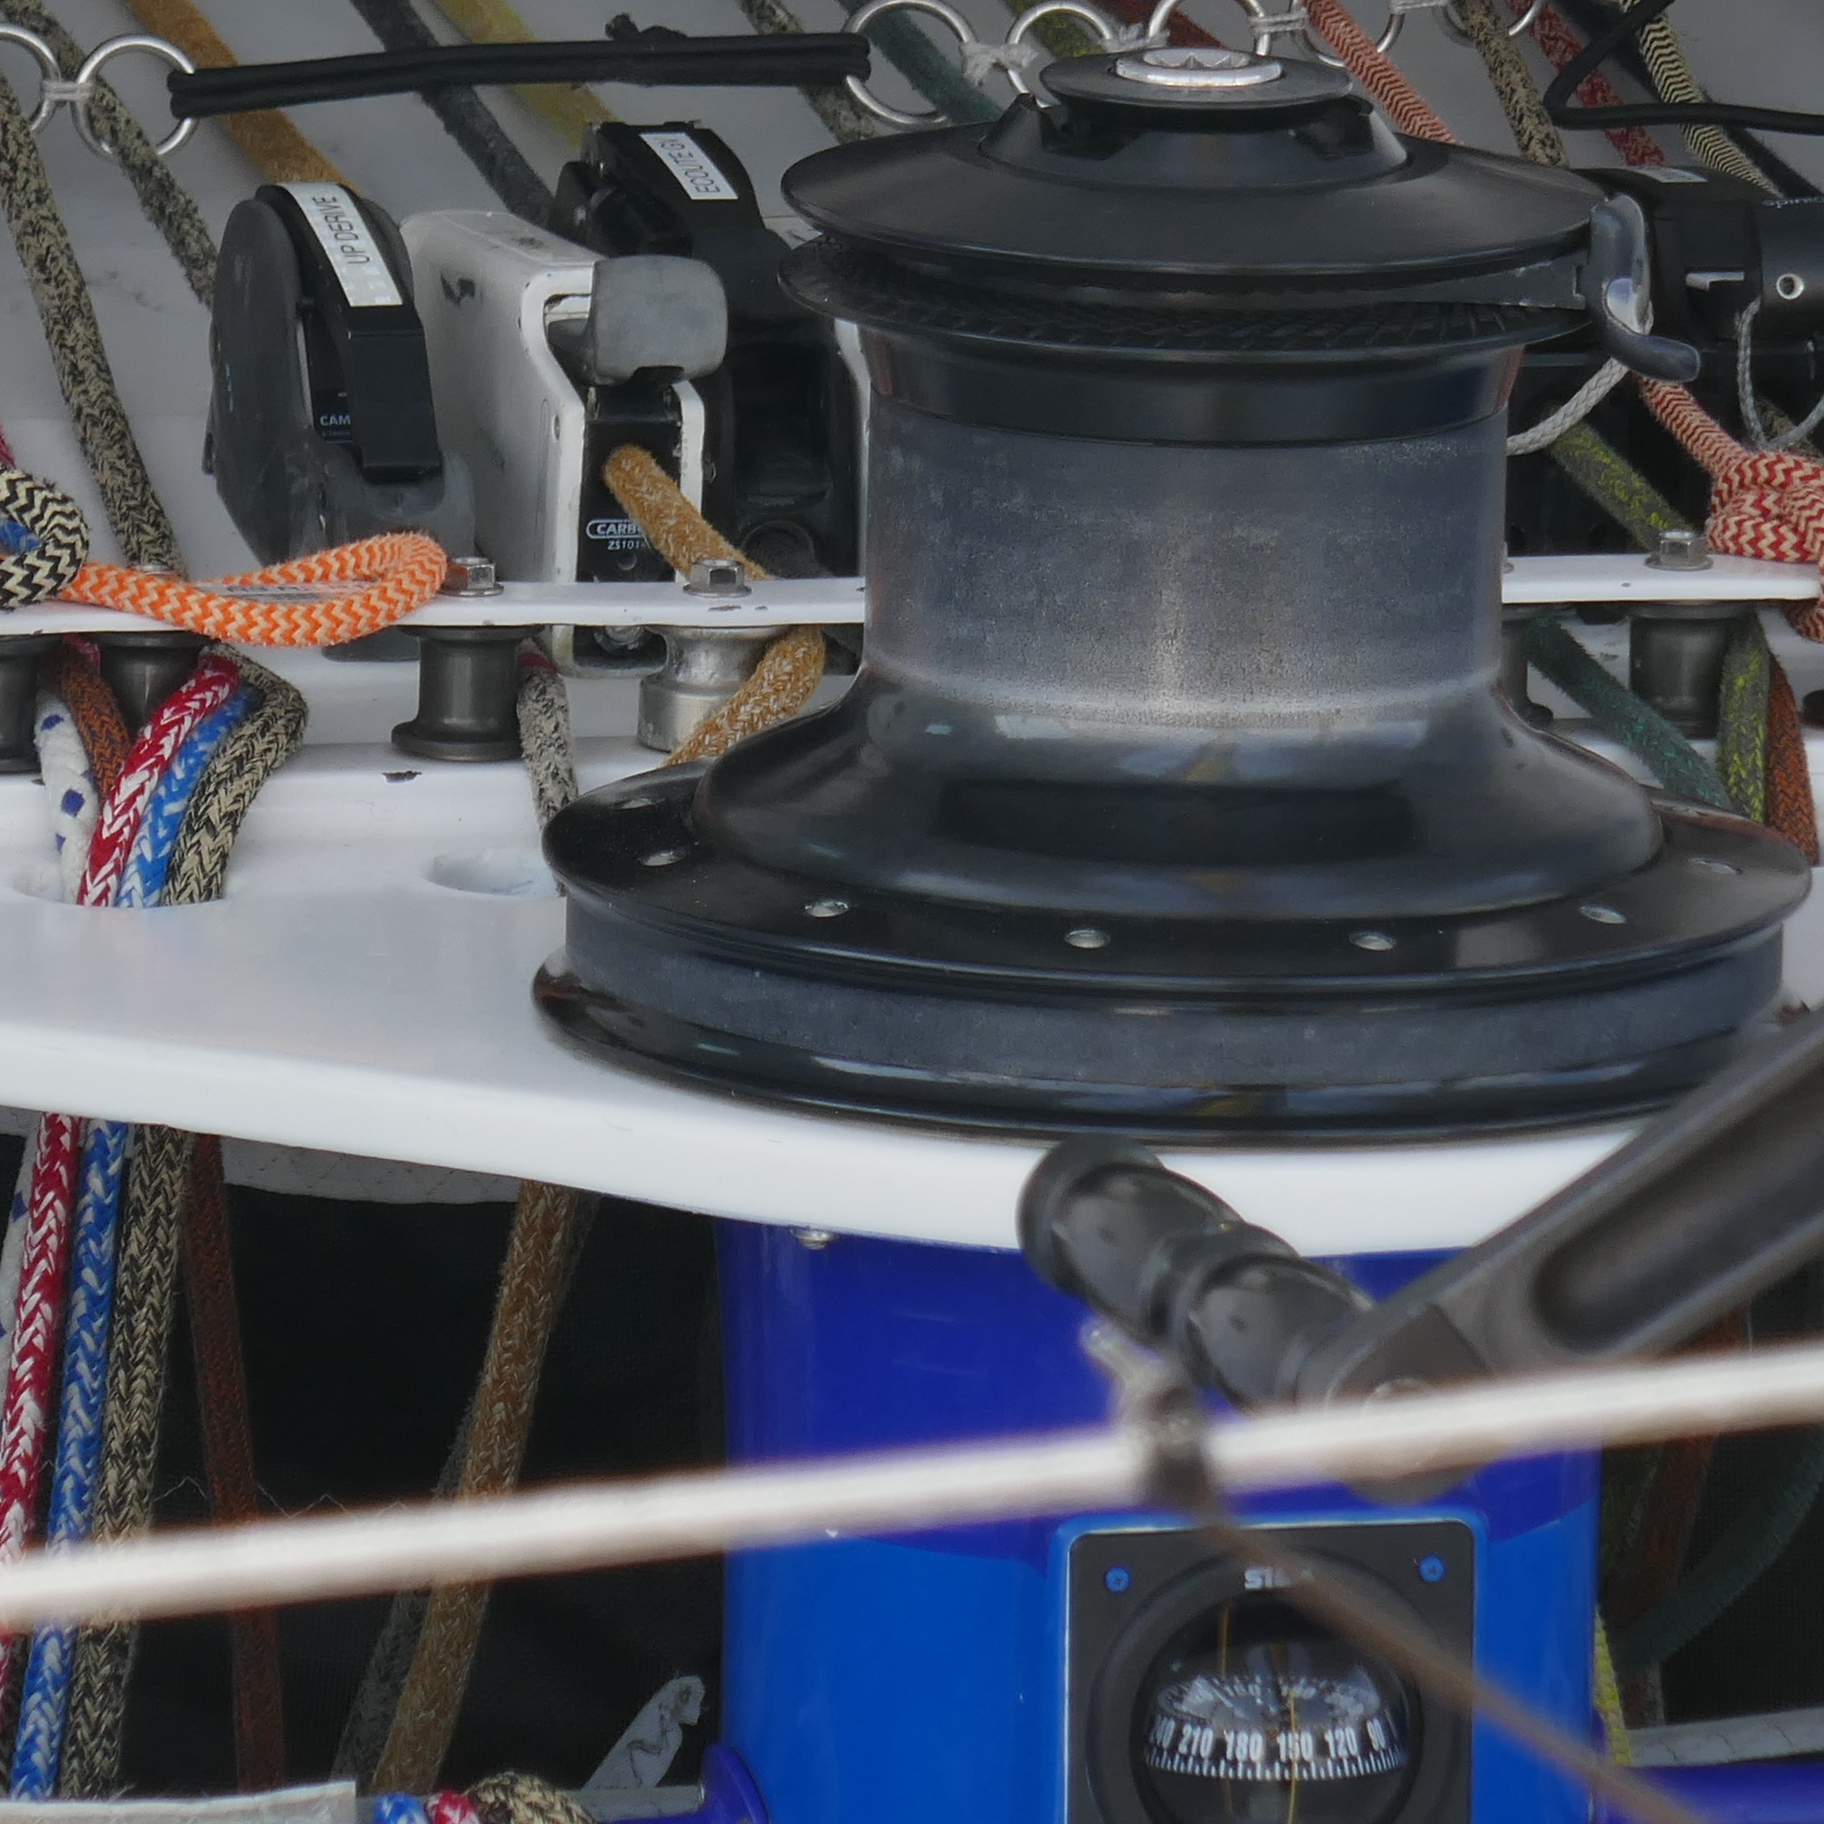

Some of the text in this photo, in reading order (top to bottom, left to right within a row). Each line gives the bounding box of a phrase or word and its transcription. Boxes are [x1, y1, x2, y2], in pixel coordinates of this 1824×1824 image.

[311, 196, 370, 264] UP DERIVE
[1178, 1723, 1214, 1759] 210
[1224, 1729, 1263, 1762] 180
[1325, 1725, 1359, 1759] 120
